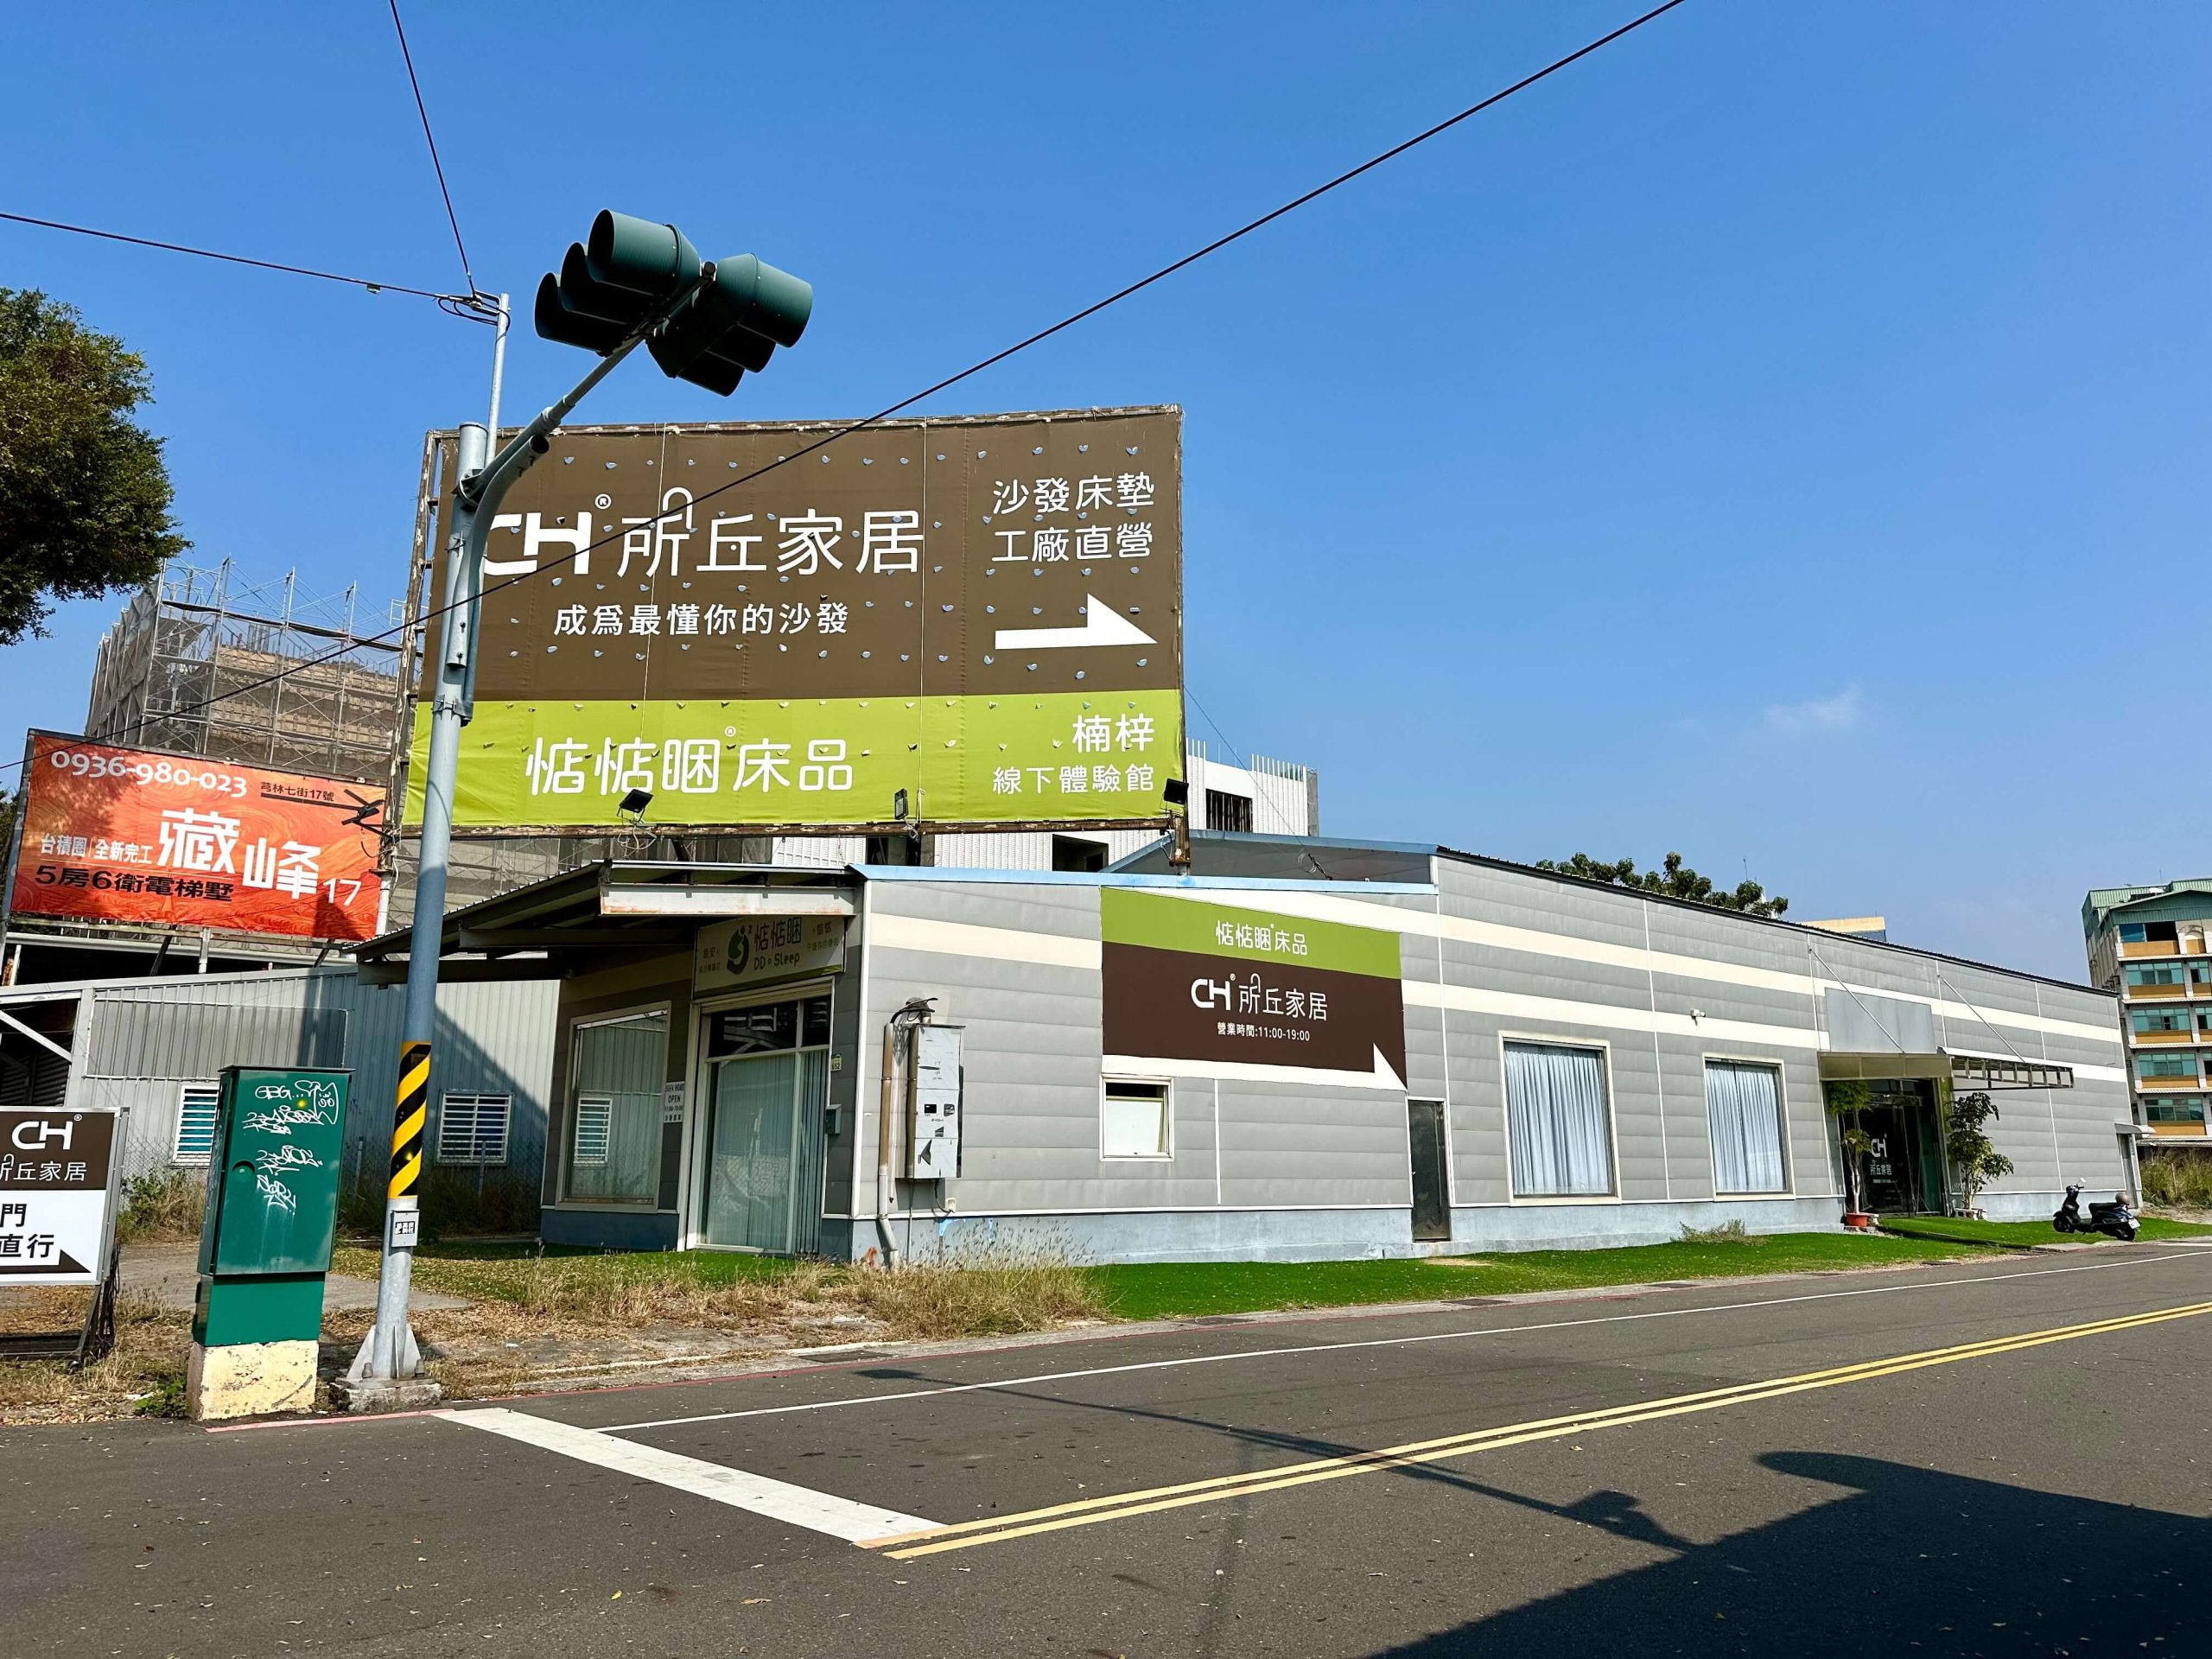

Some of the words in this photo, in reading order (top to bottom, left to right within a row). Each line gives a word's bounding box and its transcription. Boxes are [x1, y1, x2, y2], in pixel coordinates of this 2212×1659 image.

[993, 472, 1155, 517] 沙發床墊
[616, 486, 925, 578] 所丘家居
[992, 522, 1154, 564] 工廠直營
[1071, 713, 1155, 753] 楠梓
[50, 750, 248, 798] 0936-980-023
[993, 763, 1154, 795] 線下體驗館
[1191, 977, 1231, 1011] CH
[1238, 973, 1328, 1021] 所丘家居
[11, 1121, 73, 1150] CH
